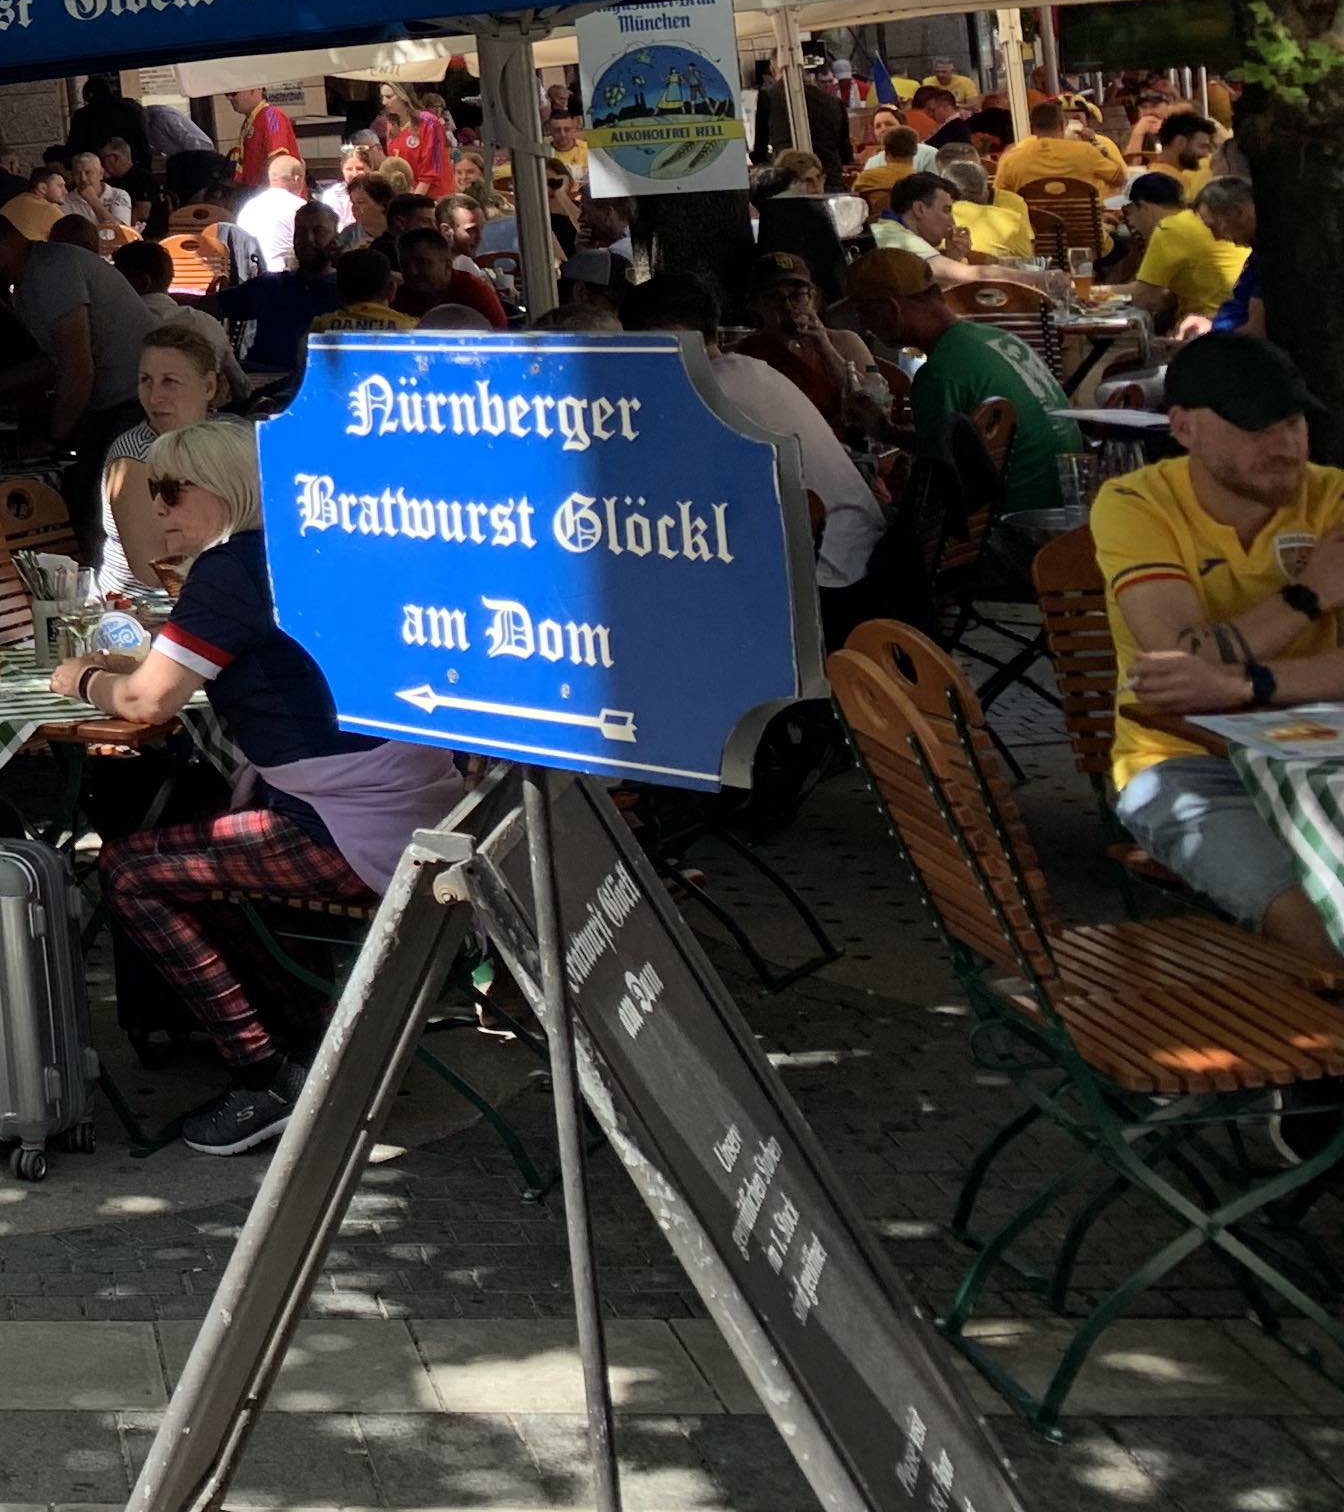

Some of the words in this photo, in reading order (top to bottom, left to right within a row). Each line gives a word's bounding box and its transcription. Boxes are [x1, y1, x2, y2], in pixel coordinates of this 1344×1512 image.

[618, 12, 691, 33] München
[612, 126, 691, 143] ALKOHOLFREI
[696, 125, 725, 137] HELL
[345, 373, 643, 452] Nürnberger
[293, 472, 538, 549] Bratwurst
[552, 490, 735, 564] Glöckl
[400, 602, 471, 652] am
[481, 594, 615, 669] Dom
[773, 1191, 800, 1244] Stock
